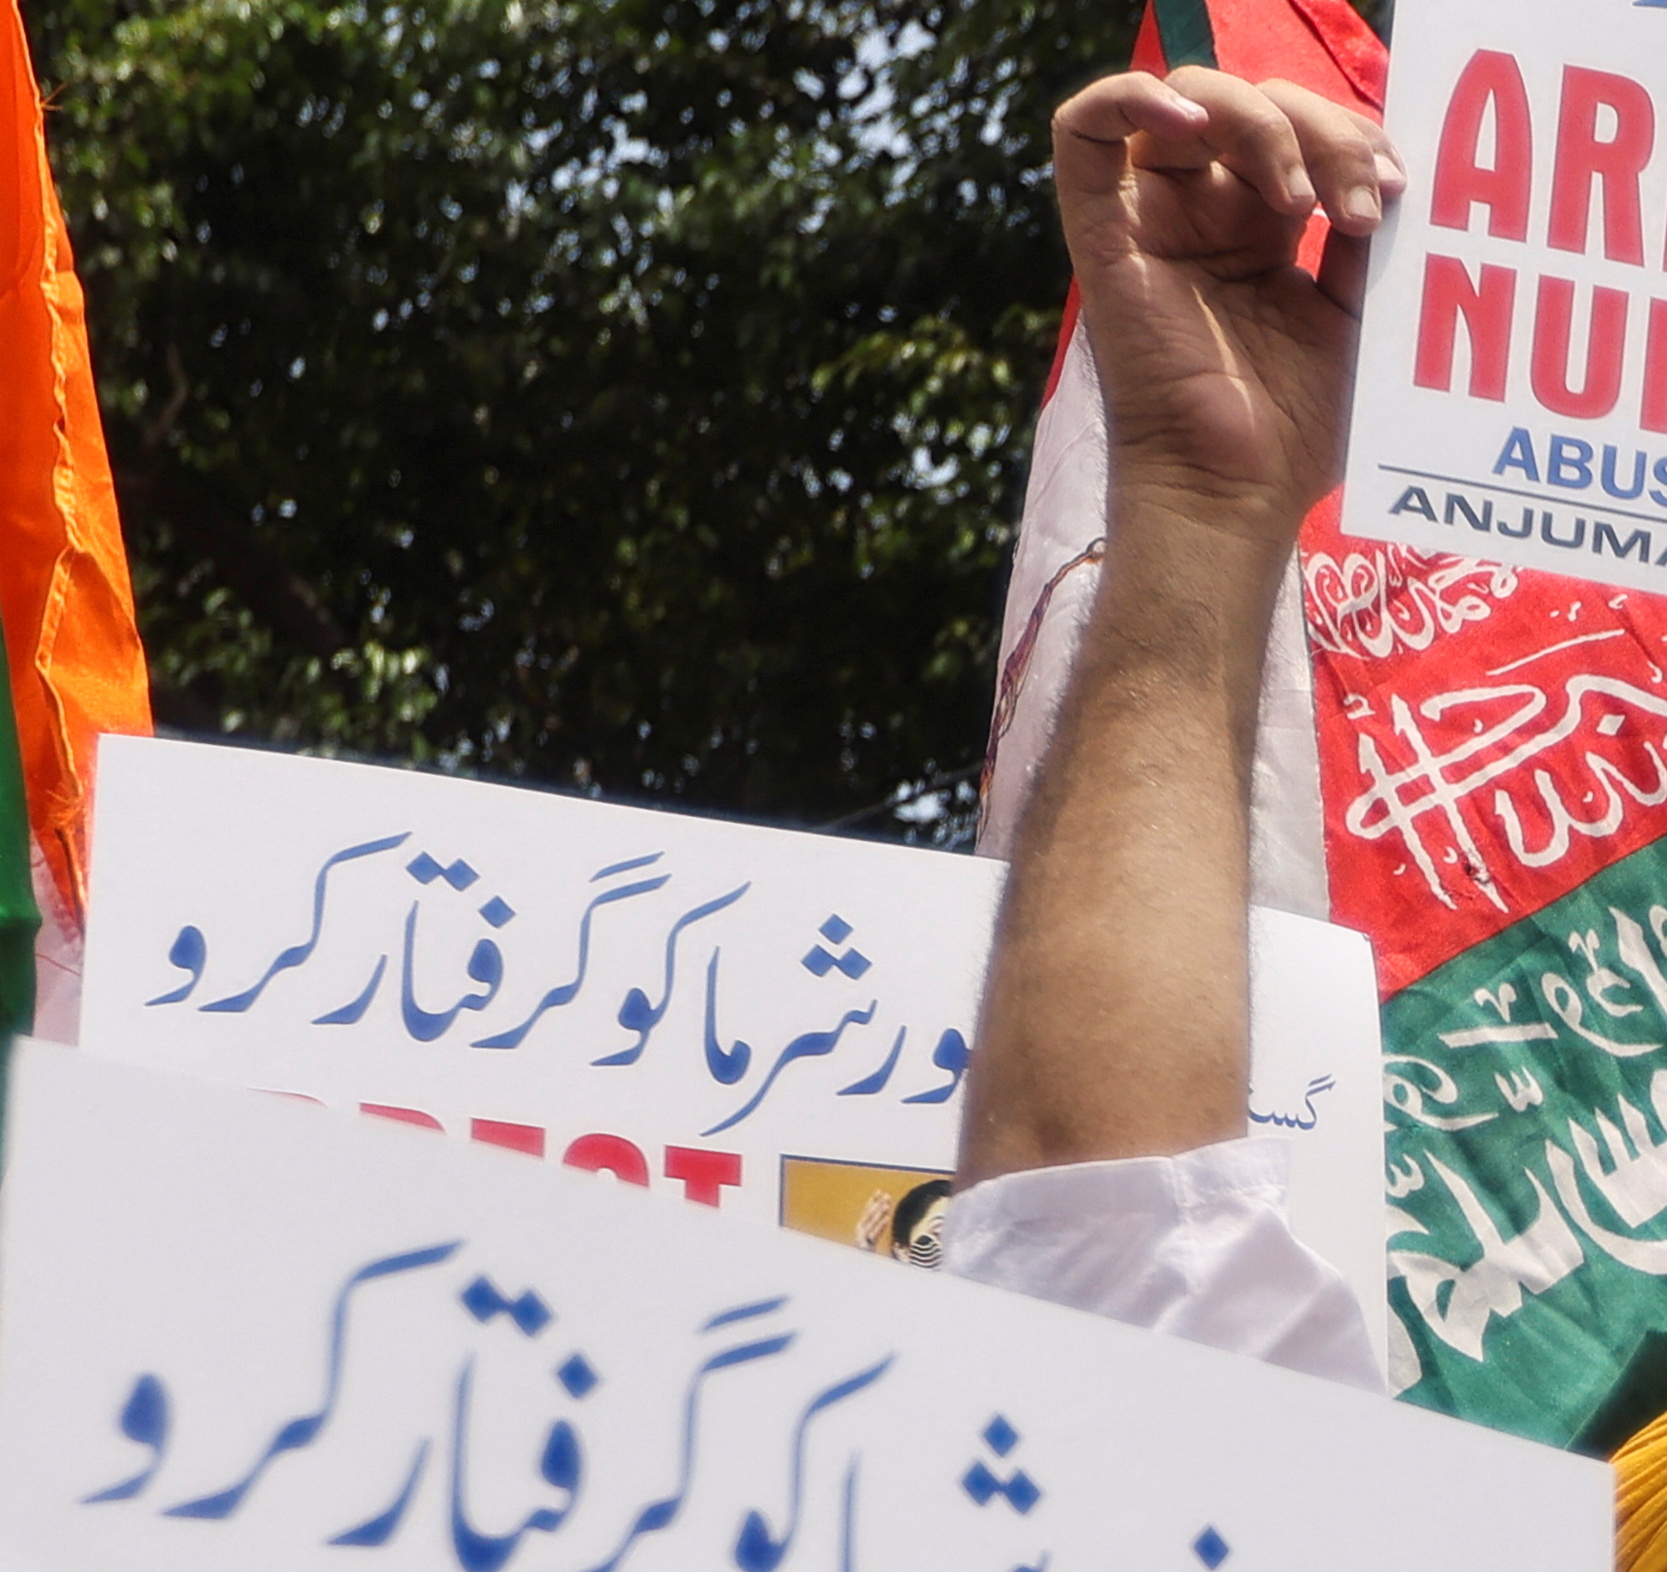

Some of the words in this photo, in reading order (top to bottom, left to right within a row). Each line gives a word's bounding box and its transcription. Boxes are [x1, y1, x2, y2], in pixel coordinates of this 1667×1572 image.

[142, 830, 412, 1016] کرو
[311, 850, 674, 1050] گرفتار
[590, 879, 751, 1067] کو
[697, 914, 871, 1137] شرما
[75, 1238, 466, 1521] کرو
